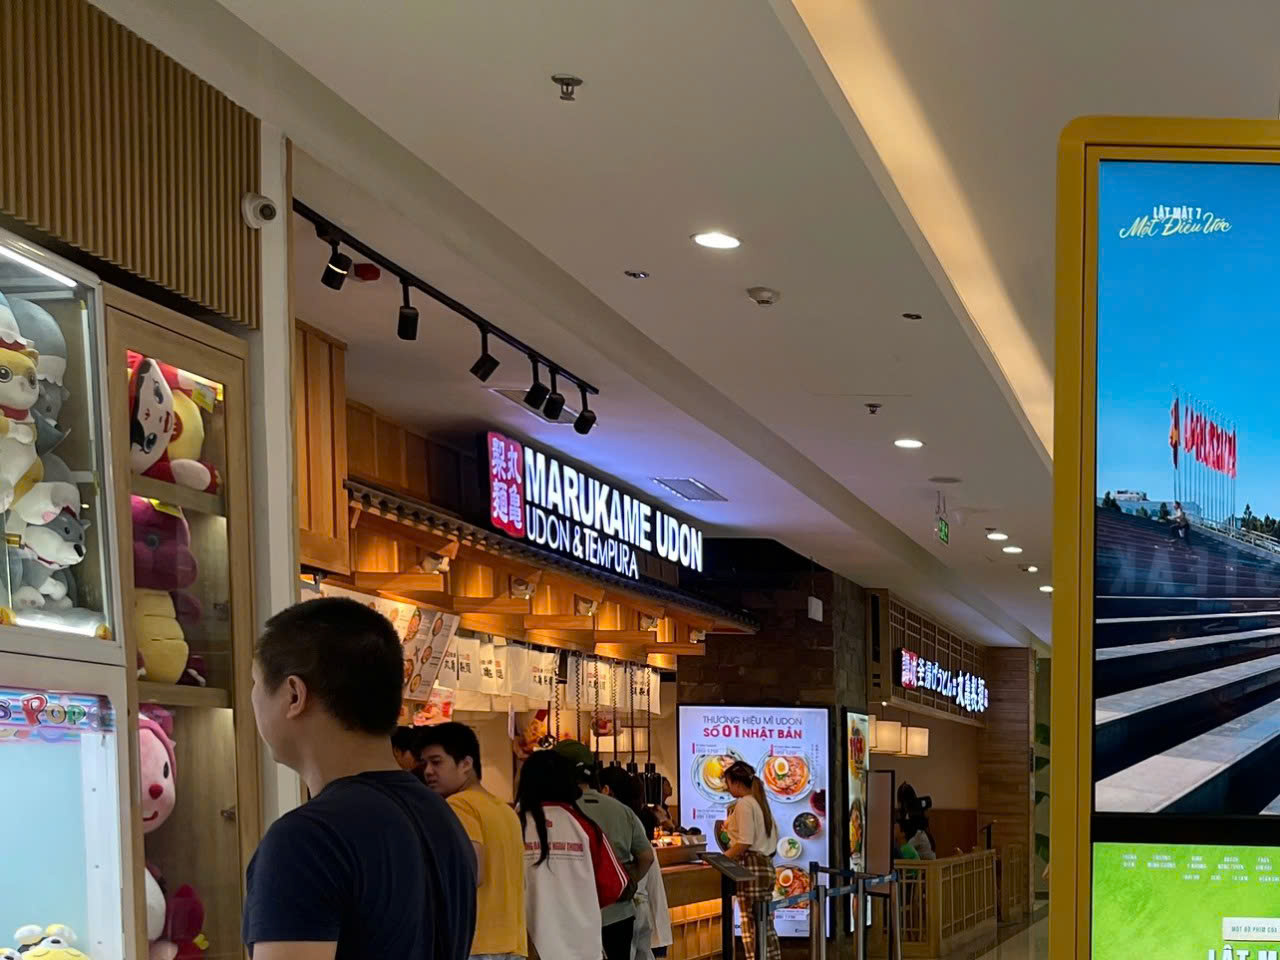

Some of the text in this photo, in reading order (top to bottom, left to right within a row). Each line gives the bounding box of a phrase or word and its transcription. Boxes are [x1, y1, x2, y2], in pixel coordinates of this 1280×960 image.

[523, 446, 703, 573] MARUKAME UDON
[525, 503, 639, 580] UDON & TEMPURA
[703, 724, 802, 741] SỐ 01 NHẬT BẢN
[742, 715, 761, 726] HIỆU
[763, 715, 774, 725] MÌ
[775, 716, 802, 726] UDON
